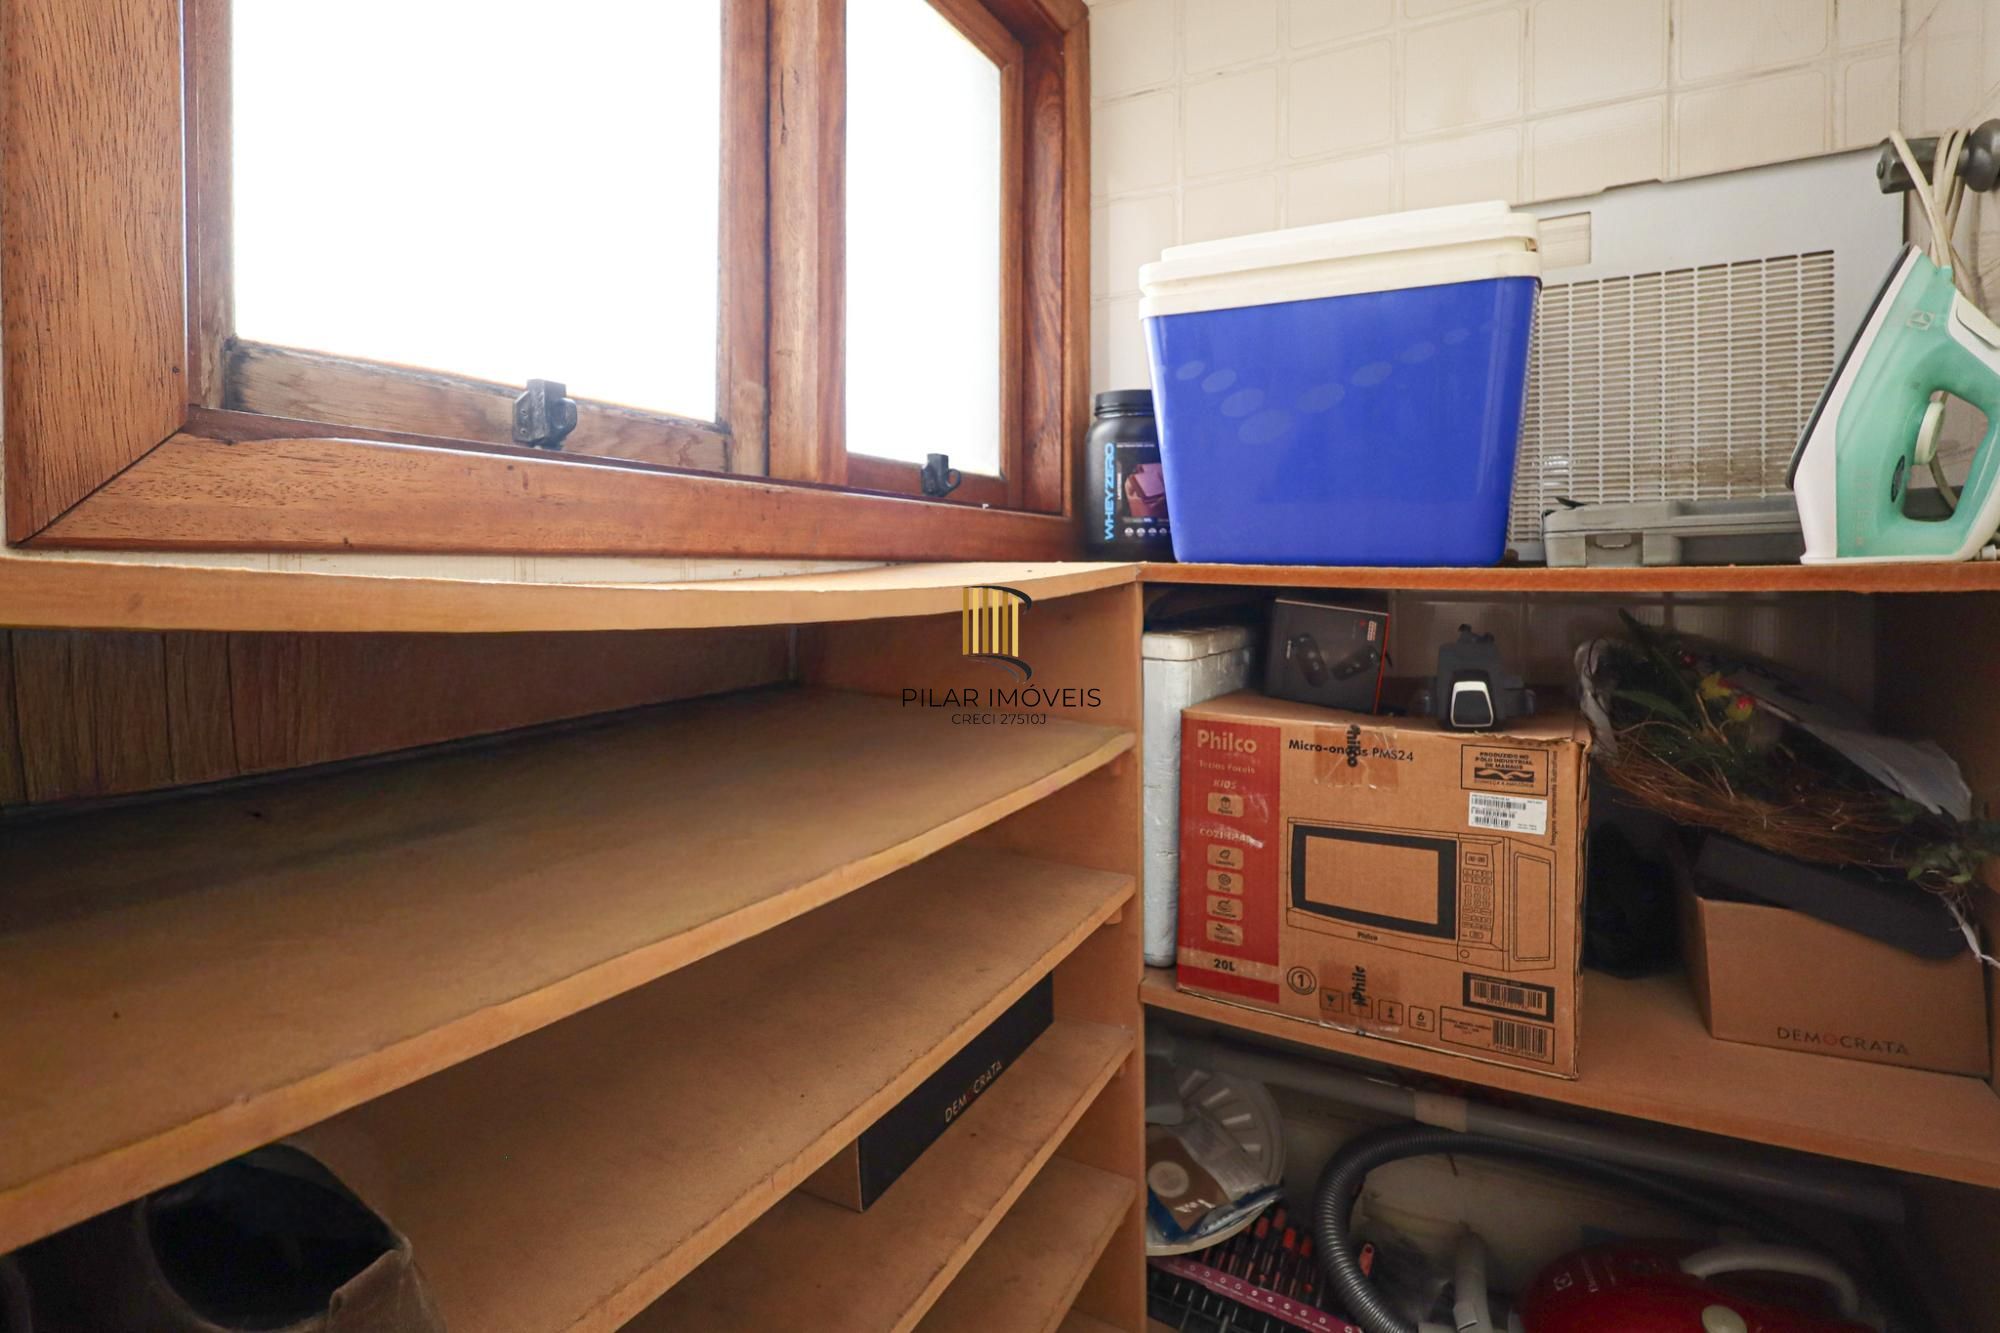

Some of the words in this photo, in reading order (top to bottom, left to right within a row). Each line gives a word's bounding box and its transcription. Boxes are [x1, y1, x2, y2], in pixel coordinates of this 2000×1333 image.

[1197, 729, 1257, 753] Philco
[1372, 748, 1414, 762] PMS24
[1213, 778, 1238, 790] KIDS
[1214, 958, 1235, 972] 20L
[1417, 1011, 1425, 1021] 6
[1777, 1026, 1909, 1055] DEMOCRATA
[945, 1060, 1003, 1123] DEMCRATA
